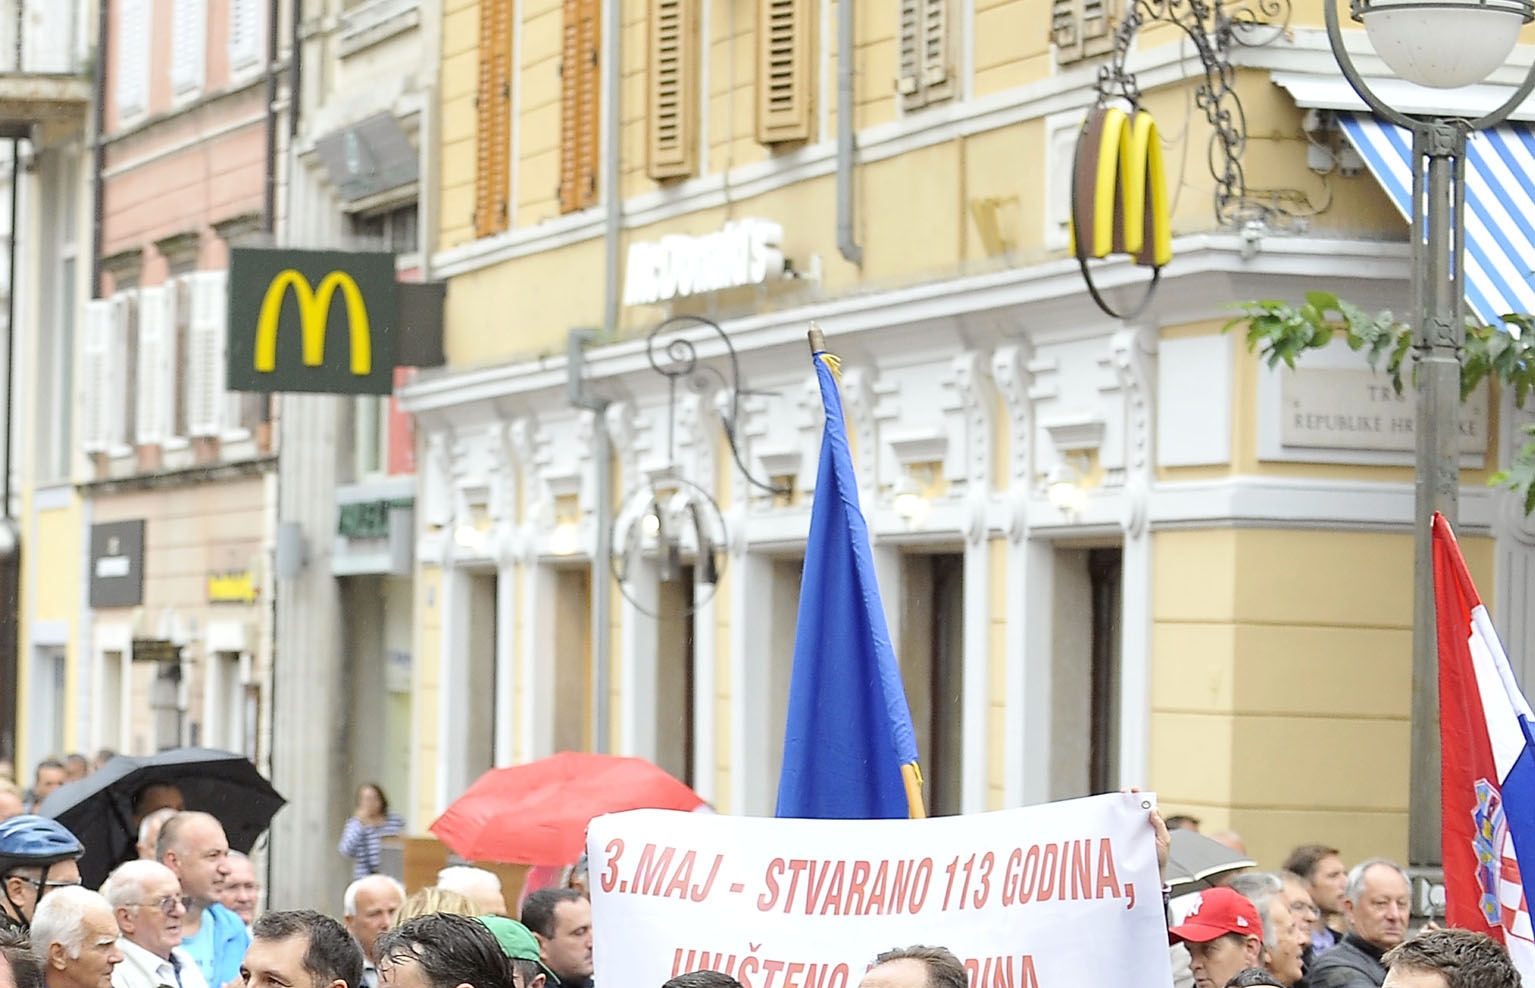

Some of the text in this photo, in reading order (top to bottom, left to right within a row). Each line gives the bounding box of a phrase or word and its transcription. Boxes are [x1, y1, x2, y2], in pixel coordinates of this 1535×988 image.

[1294, 414, 1477, 437] REPUBLIKE HRKE
[600, 838, 724, 903] 3.MAJ
[757, 856, 934, 916] STVARANO
[941, 851, 995, 912] 113
[1001, 837, 1138, 911] GODINA,
